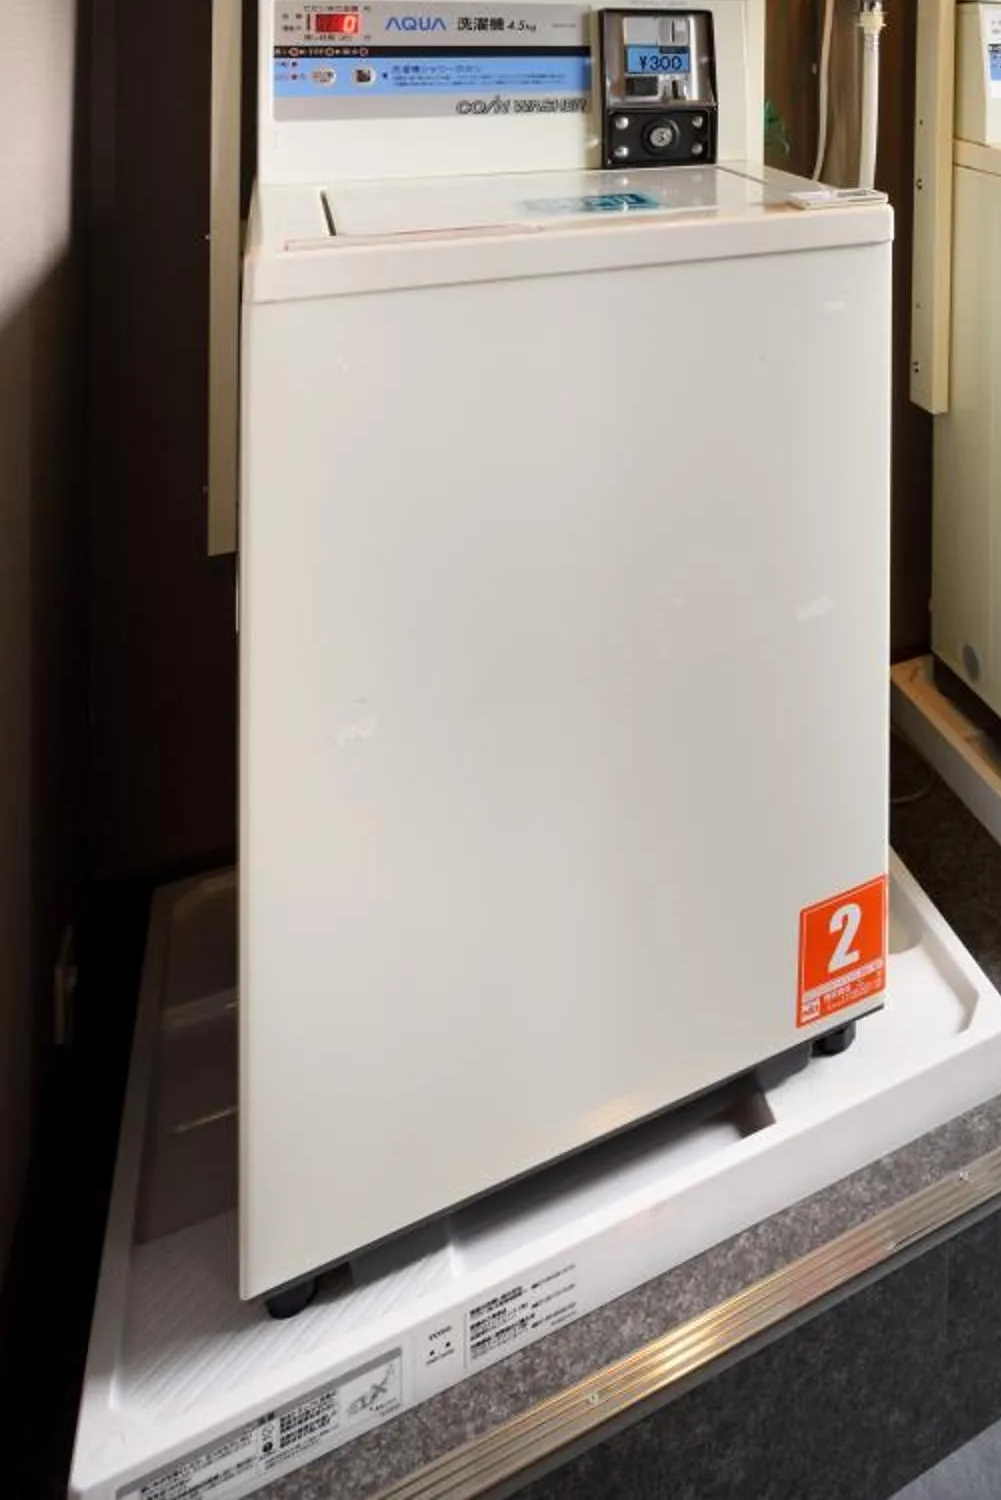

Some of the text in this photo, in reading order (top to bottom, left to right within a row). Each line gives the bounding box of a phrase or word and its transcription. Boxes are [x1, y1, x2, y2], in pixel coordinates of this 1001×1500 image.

[343, 15, 356, 32] 0
[385, 16, 448, 32] AQUA
[639, 55, 683, 71] ¥300
[827, 903, 863, 973] 2
